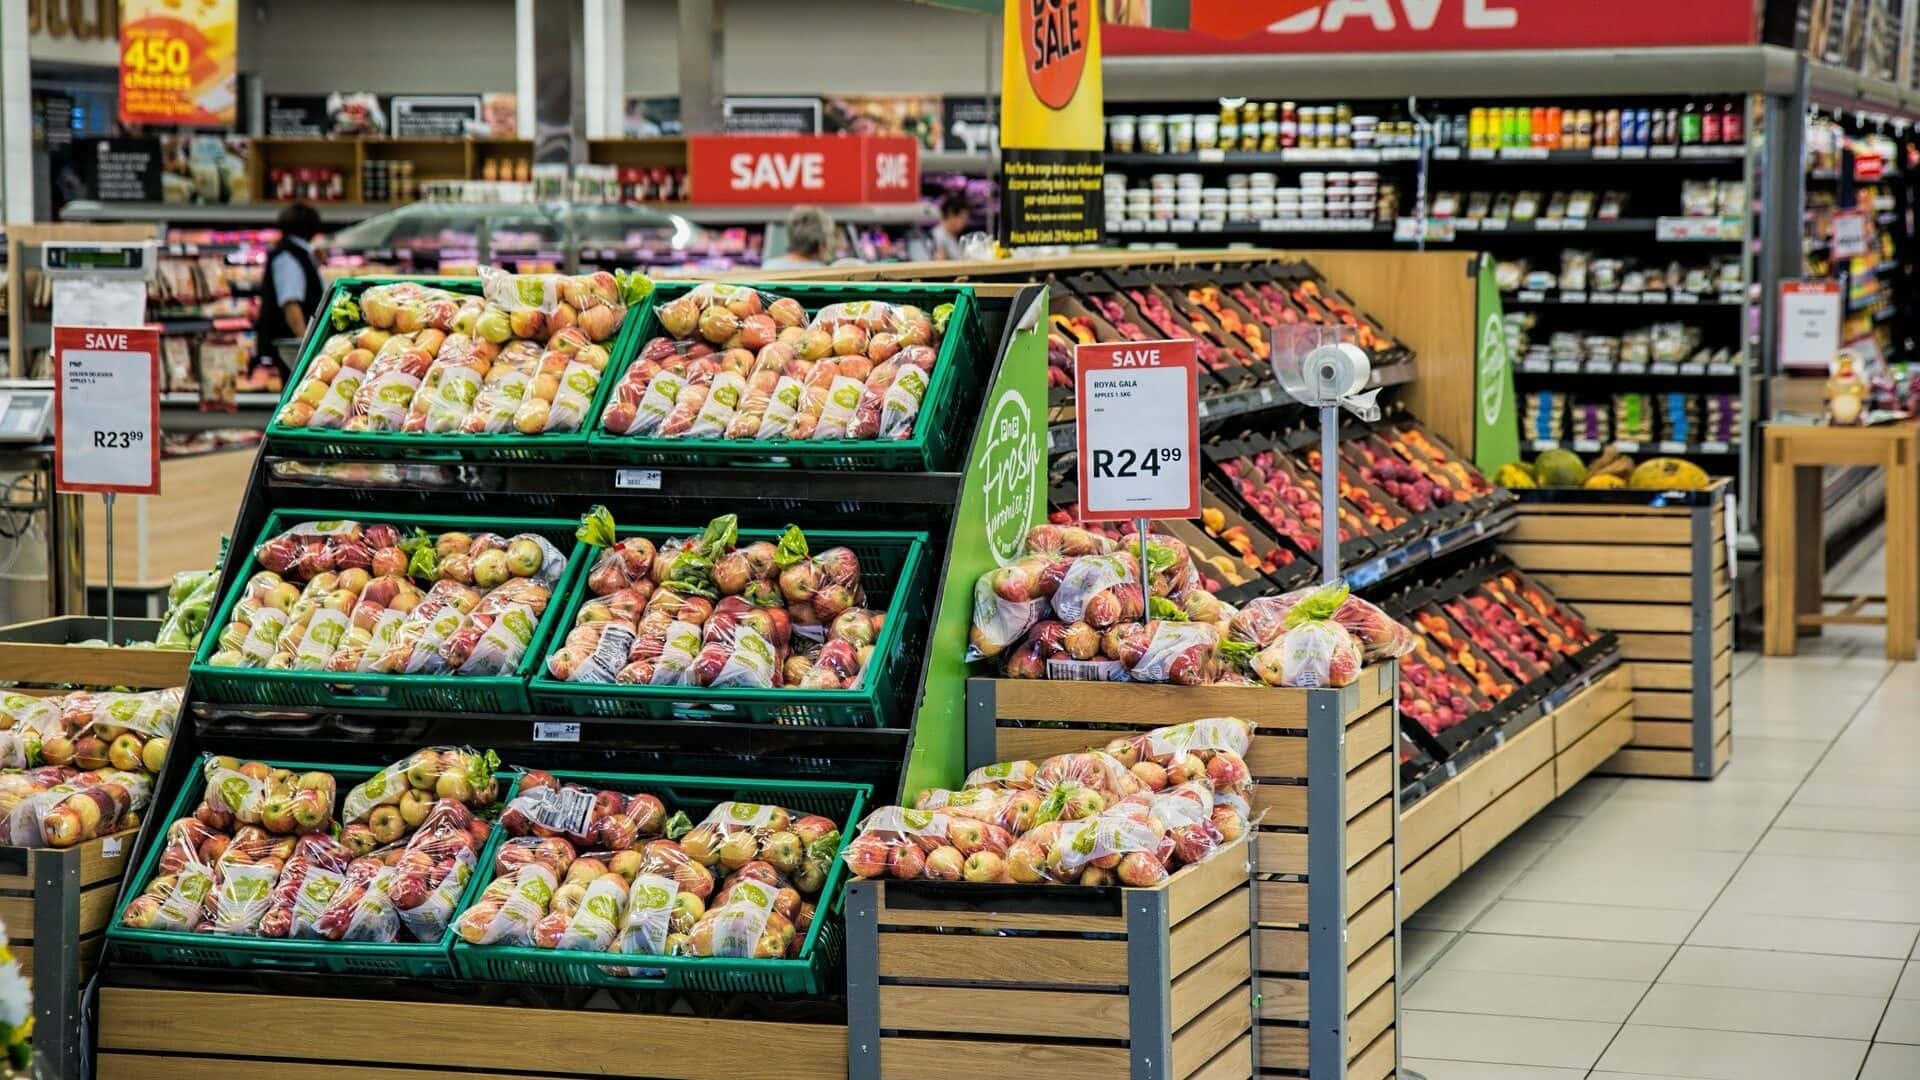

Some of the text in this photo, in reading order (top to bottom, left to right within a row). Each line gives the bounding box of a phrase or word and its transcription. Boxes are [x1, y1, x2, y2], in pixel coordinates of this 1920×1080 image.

[1032, 0, 1082, 71] SALE
[123, 38, 190, 73] 450
[730, 152, 825, 190] SAVE
[875, 152, 908, 189] SAVE
[85, 333, 128, 350] SAVE
[1111, 349, 1160, 368] SAVE
[1094, 380, 1138, 389] ROYAL GALA
[979, 408, 1041, 505] Fresh
